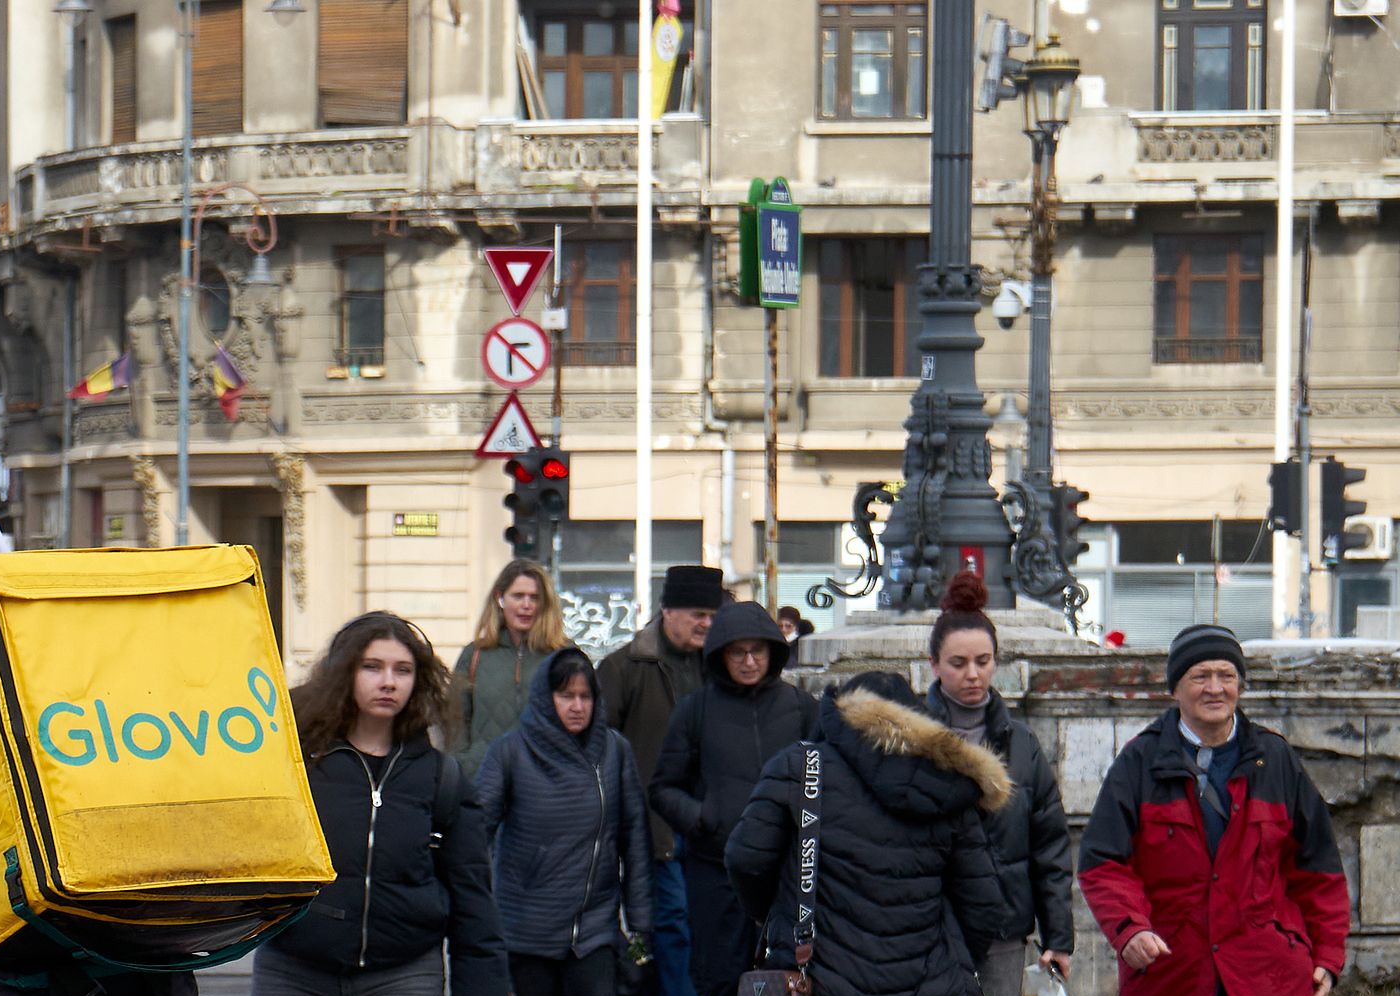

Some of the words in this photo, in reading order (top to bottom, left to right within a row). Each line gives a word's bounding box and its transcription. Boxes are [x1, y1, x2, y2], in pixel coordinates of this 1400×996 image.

[38, 699, 264, 767] Glovo
[804, 749, 820, 799] GUESS
[800, 838, 816, 893] GUESS
